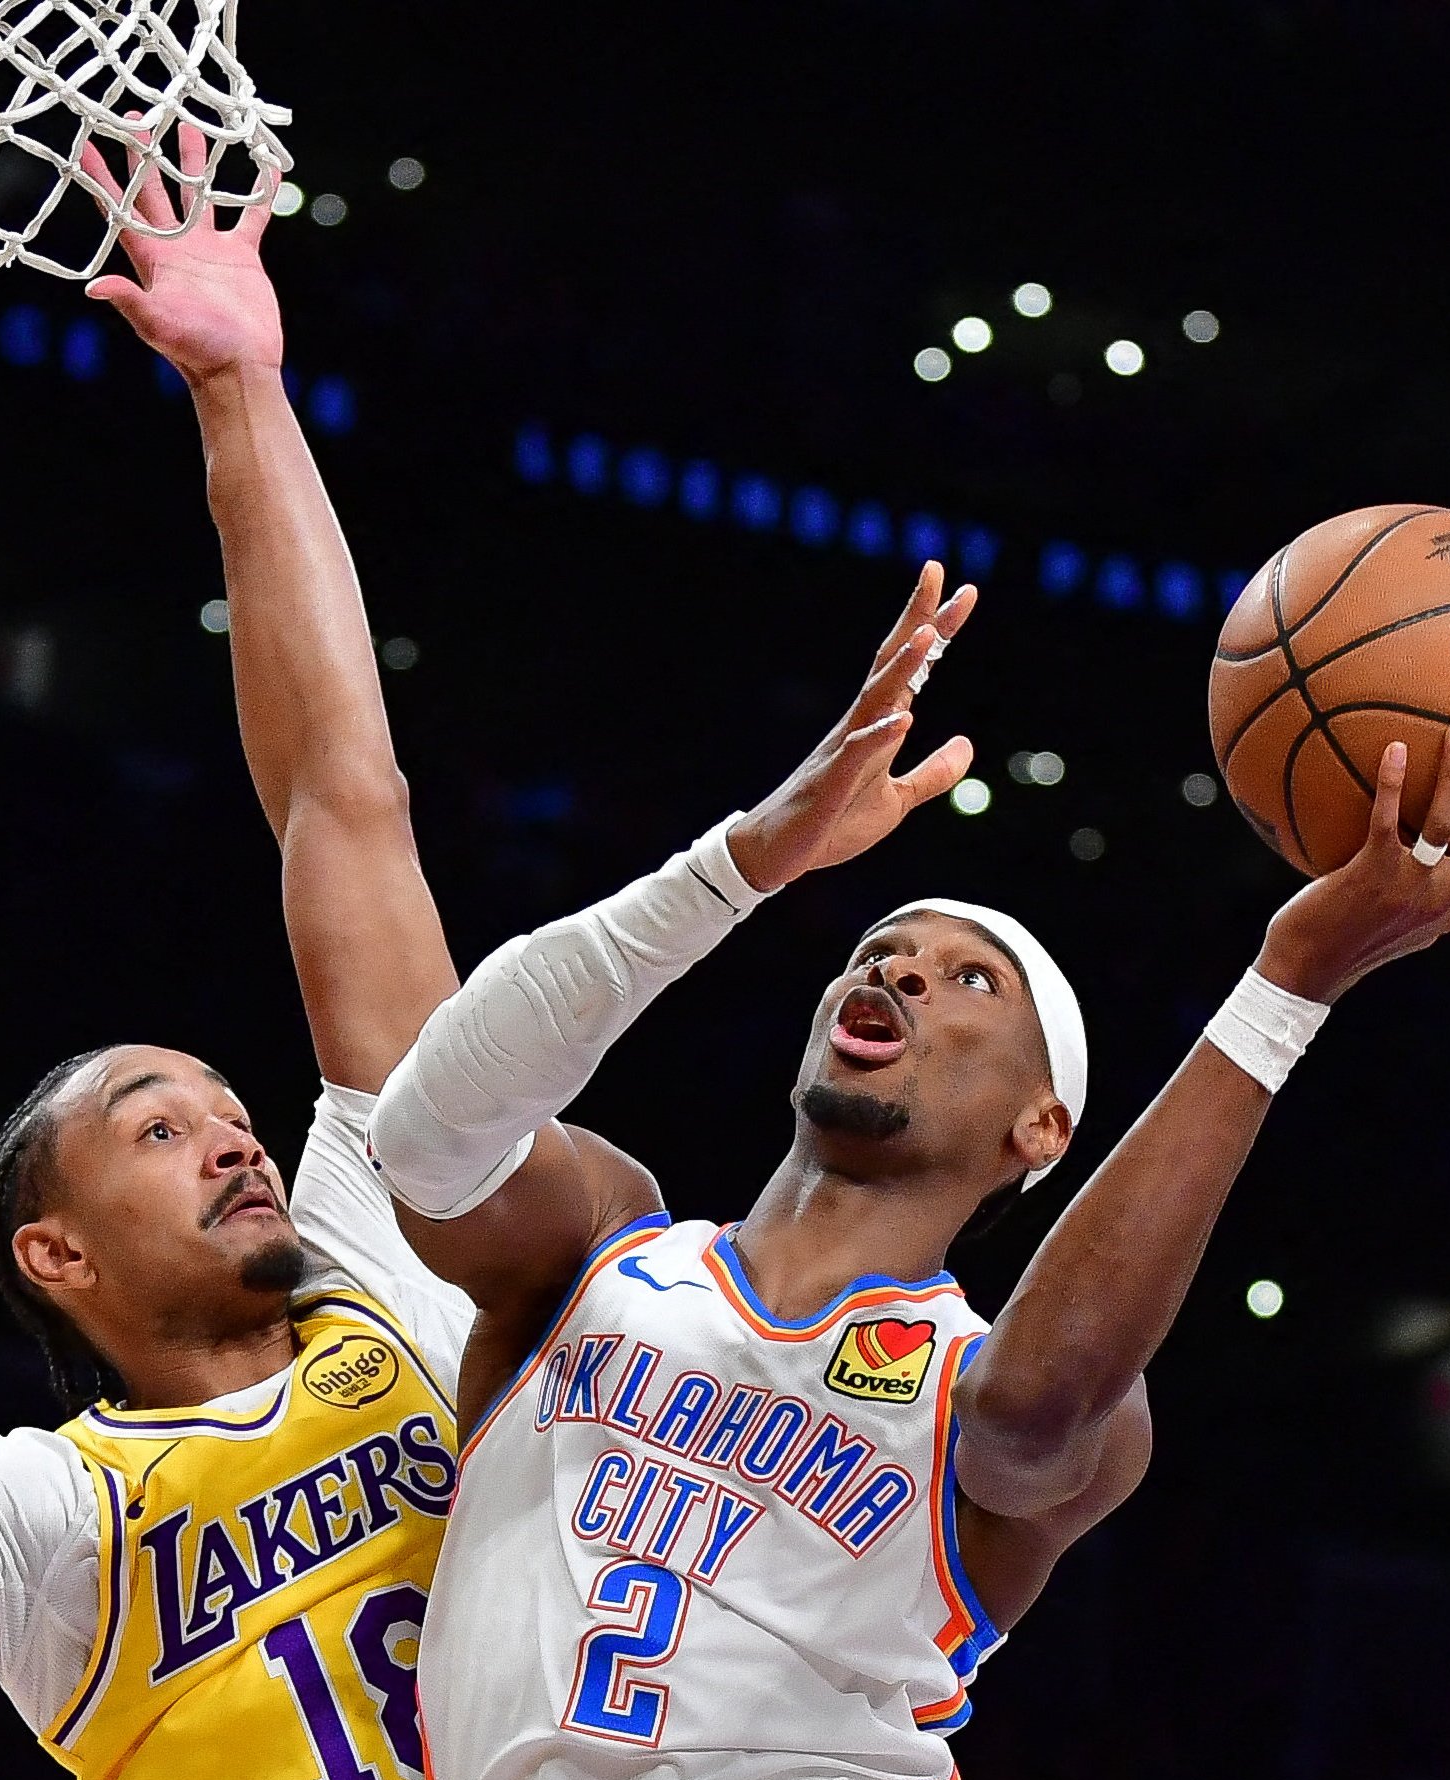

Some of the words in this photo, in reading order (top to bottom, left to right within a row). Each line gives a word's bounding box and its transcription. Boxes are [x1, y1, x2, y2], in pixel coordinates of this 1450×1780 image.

[309, 1347, 387, 1395] bibigo
[535, 1333, 916, 1560] OKLAHOMA
[141, 1413, 457, 1687] LAKERS
[571, 1448, 766, 1585] CITY
[560, 1555, 692, 1748] 2
